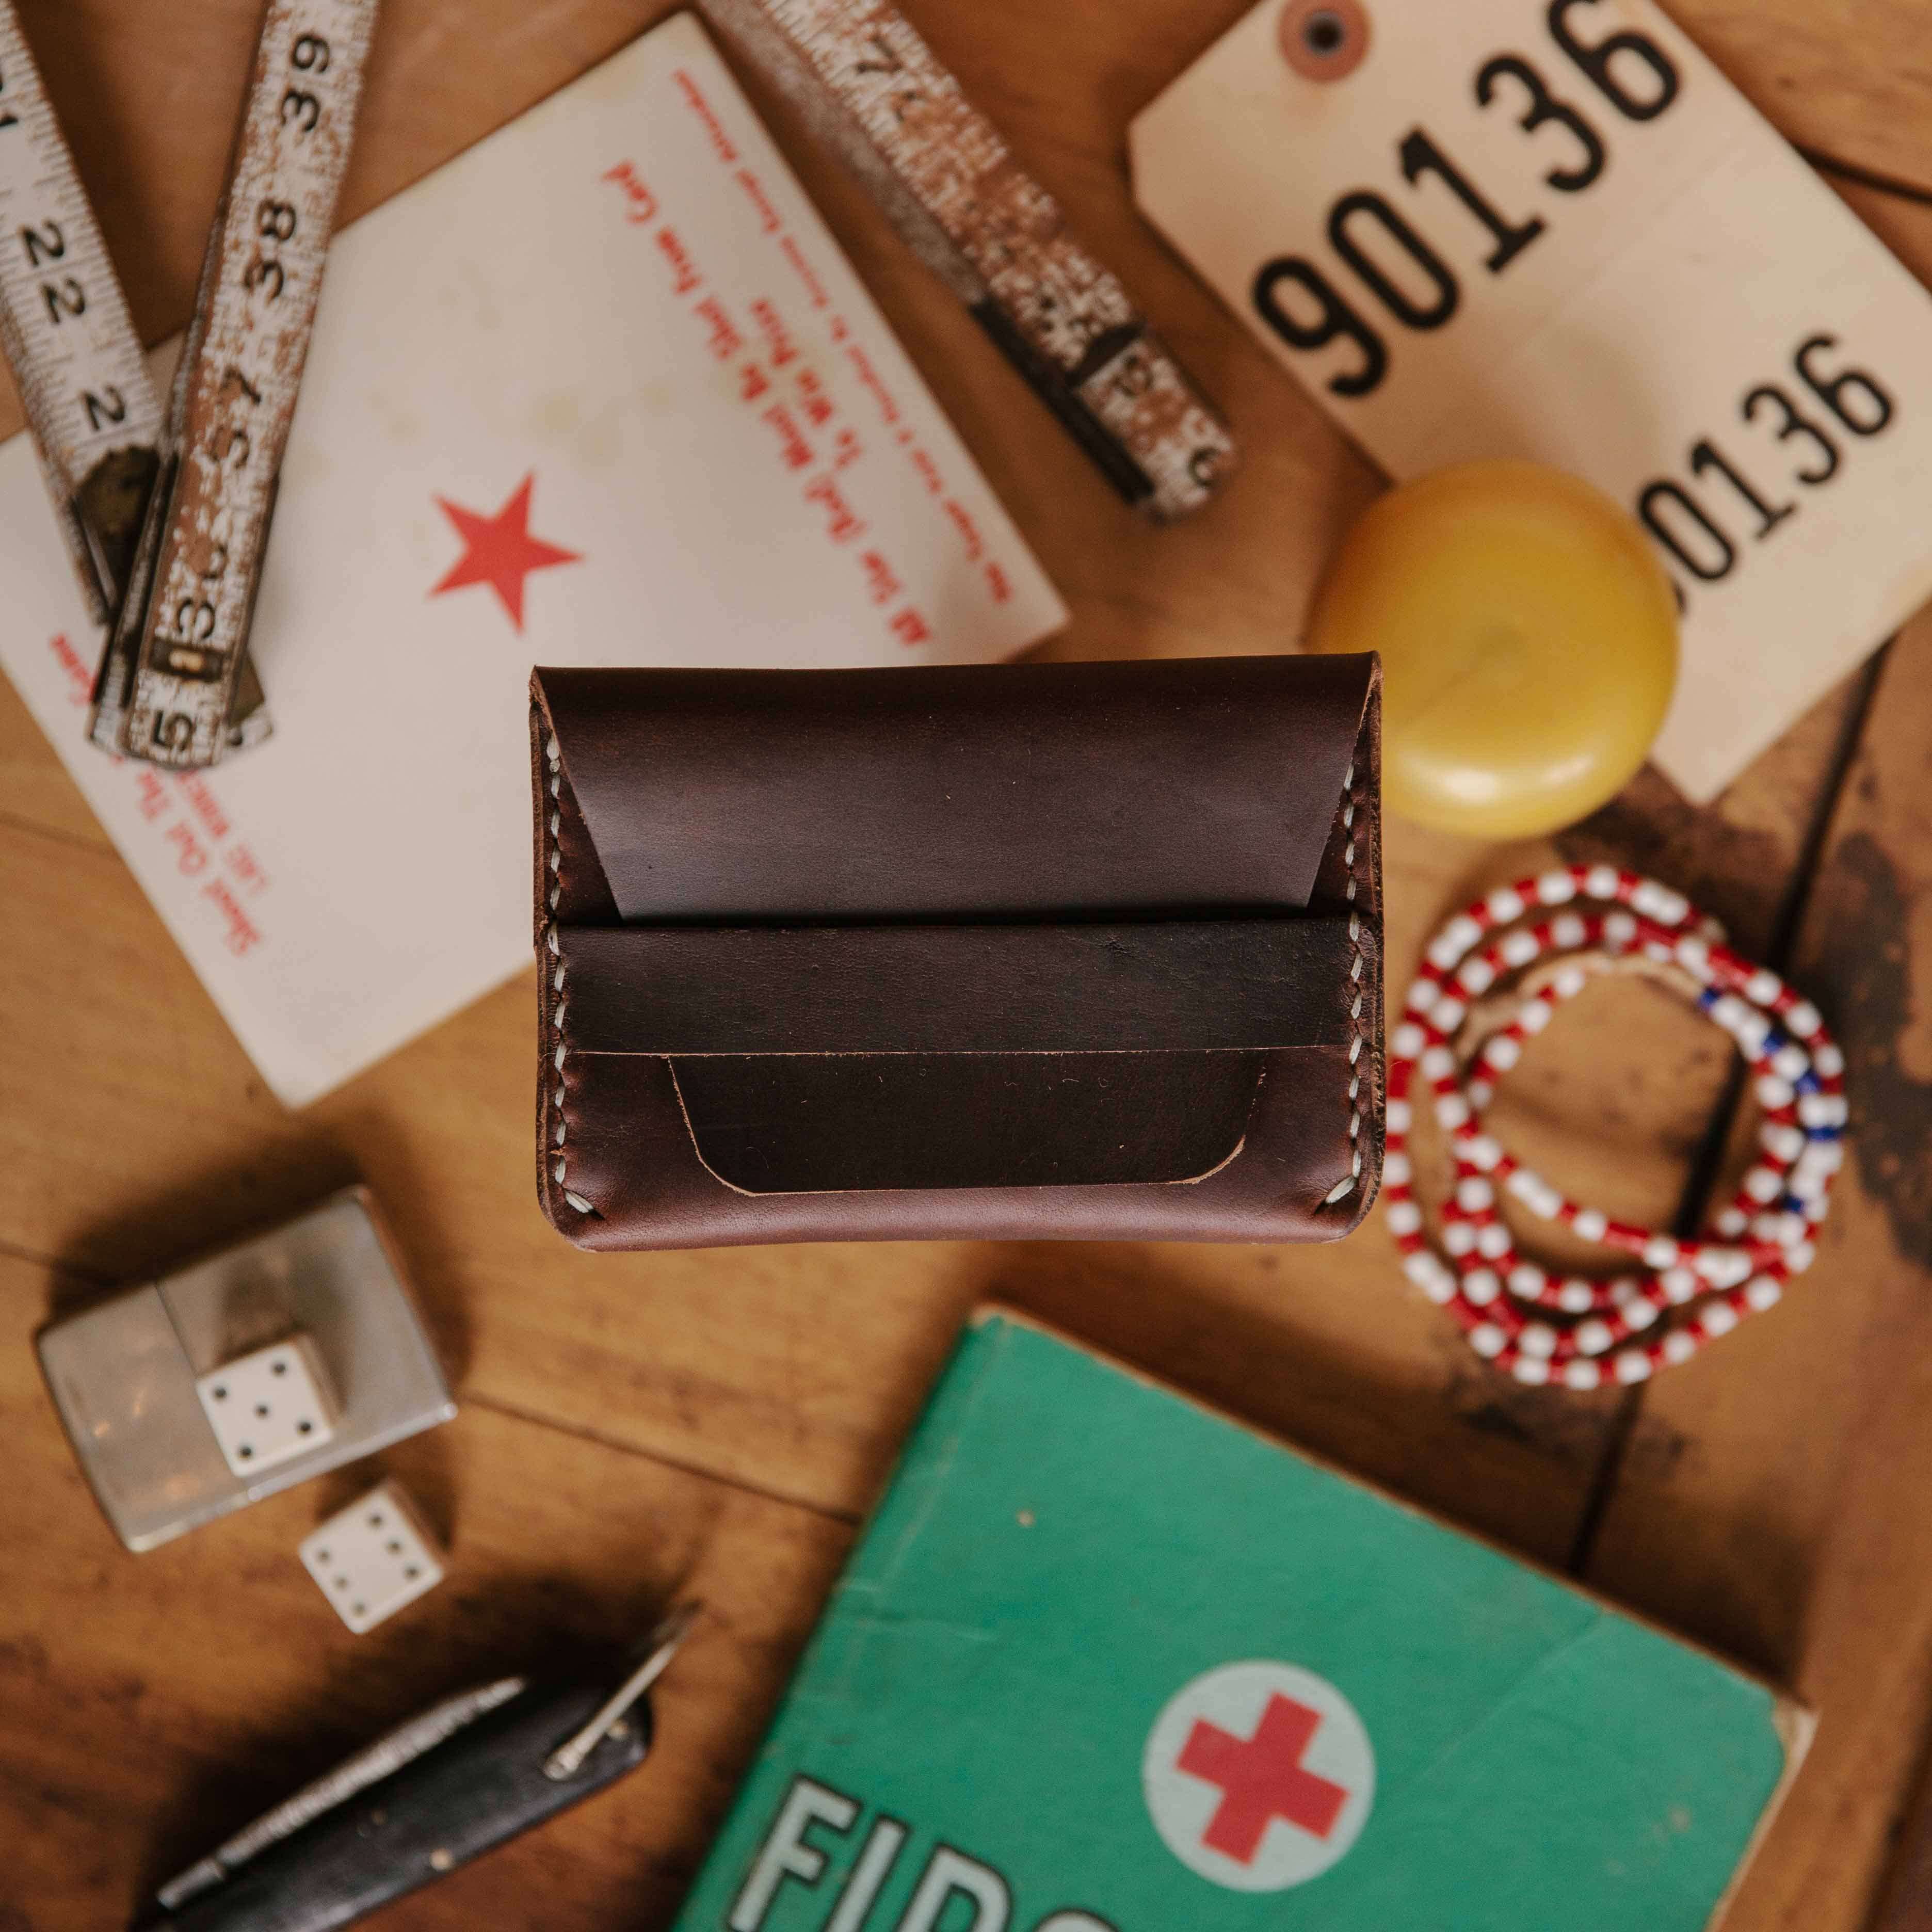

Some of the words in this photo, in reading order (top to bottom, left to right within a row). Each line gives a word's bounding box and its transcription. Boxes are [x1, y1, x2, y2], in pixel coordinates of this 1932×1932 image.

[243, 198, 297, 305] 38
[280, 31, 331, 133] 39
[602, 160, 659, 227] Card
[1251, 0, 1680, 397] 90136
[18, 218, 87, 326] 22
[653, 225, 704, 297] From
[691, 296, 744, 363] Shot
[749, 298, 800, 369] Prize
[739, 362, 772, 404] Be
[795, 368, 834, 429] Win
[761, 403, 816, 472] Must
[831, 428, 861, 472] To
[1637, 335, 1892, 615] 0136
[727, 1773, 1121, 1932] FI
